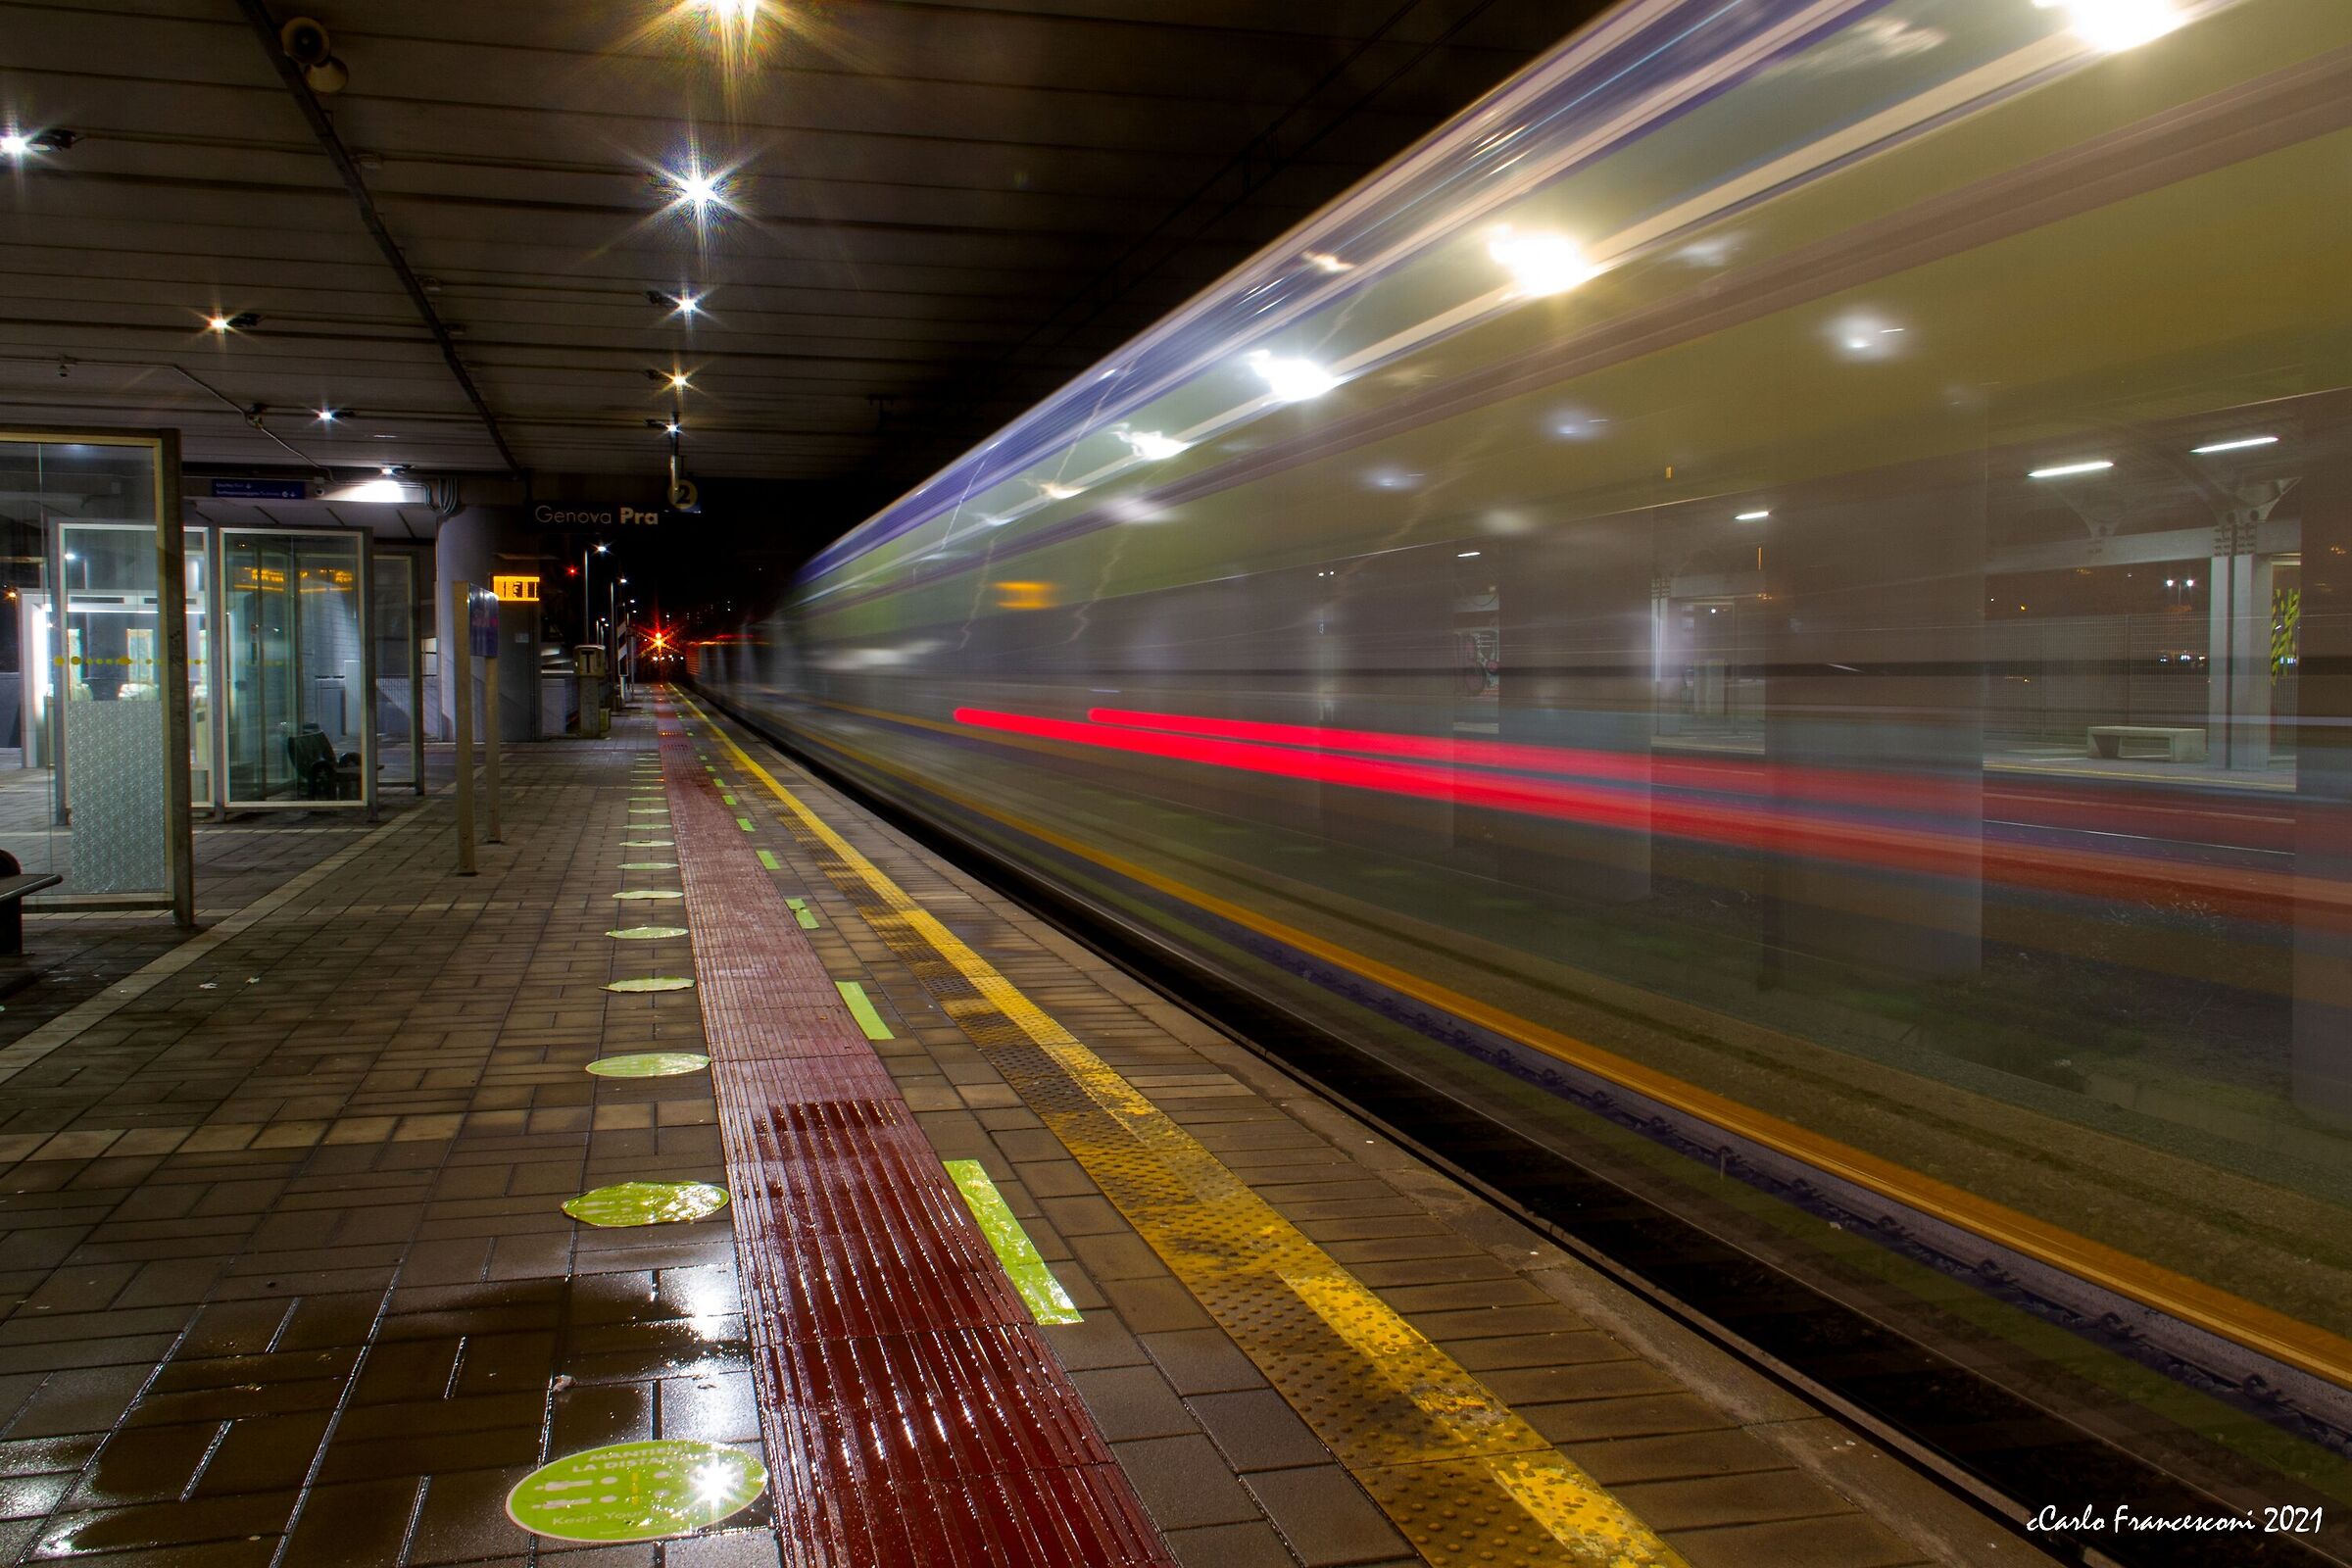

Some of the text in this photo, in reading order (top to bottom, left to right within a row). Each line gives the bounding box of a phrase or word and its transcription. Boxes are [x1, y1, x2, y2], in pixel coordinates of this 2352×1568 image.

[675, 485, 691, 504] 2
[535, 505, 660, 525] Genova Pra
[572, 1464, 597, 1473] LA
[552, 1514, 599, 1526] Keep
[604, 1510, 644, 1521] Your
